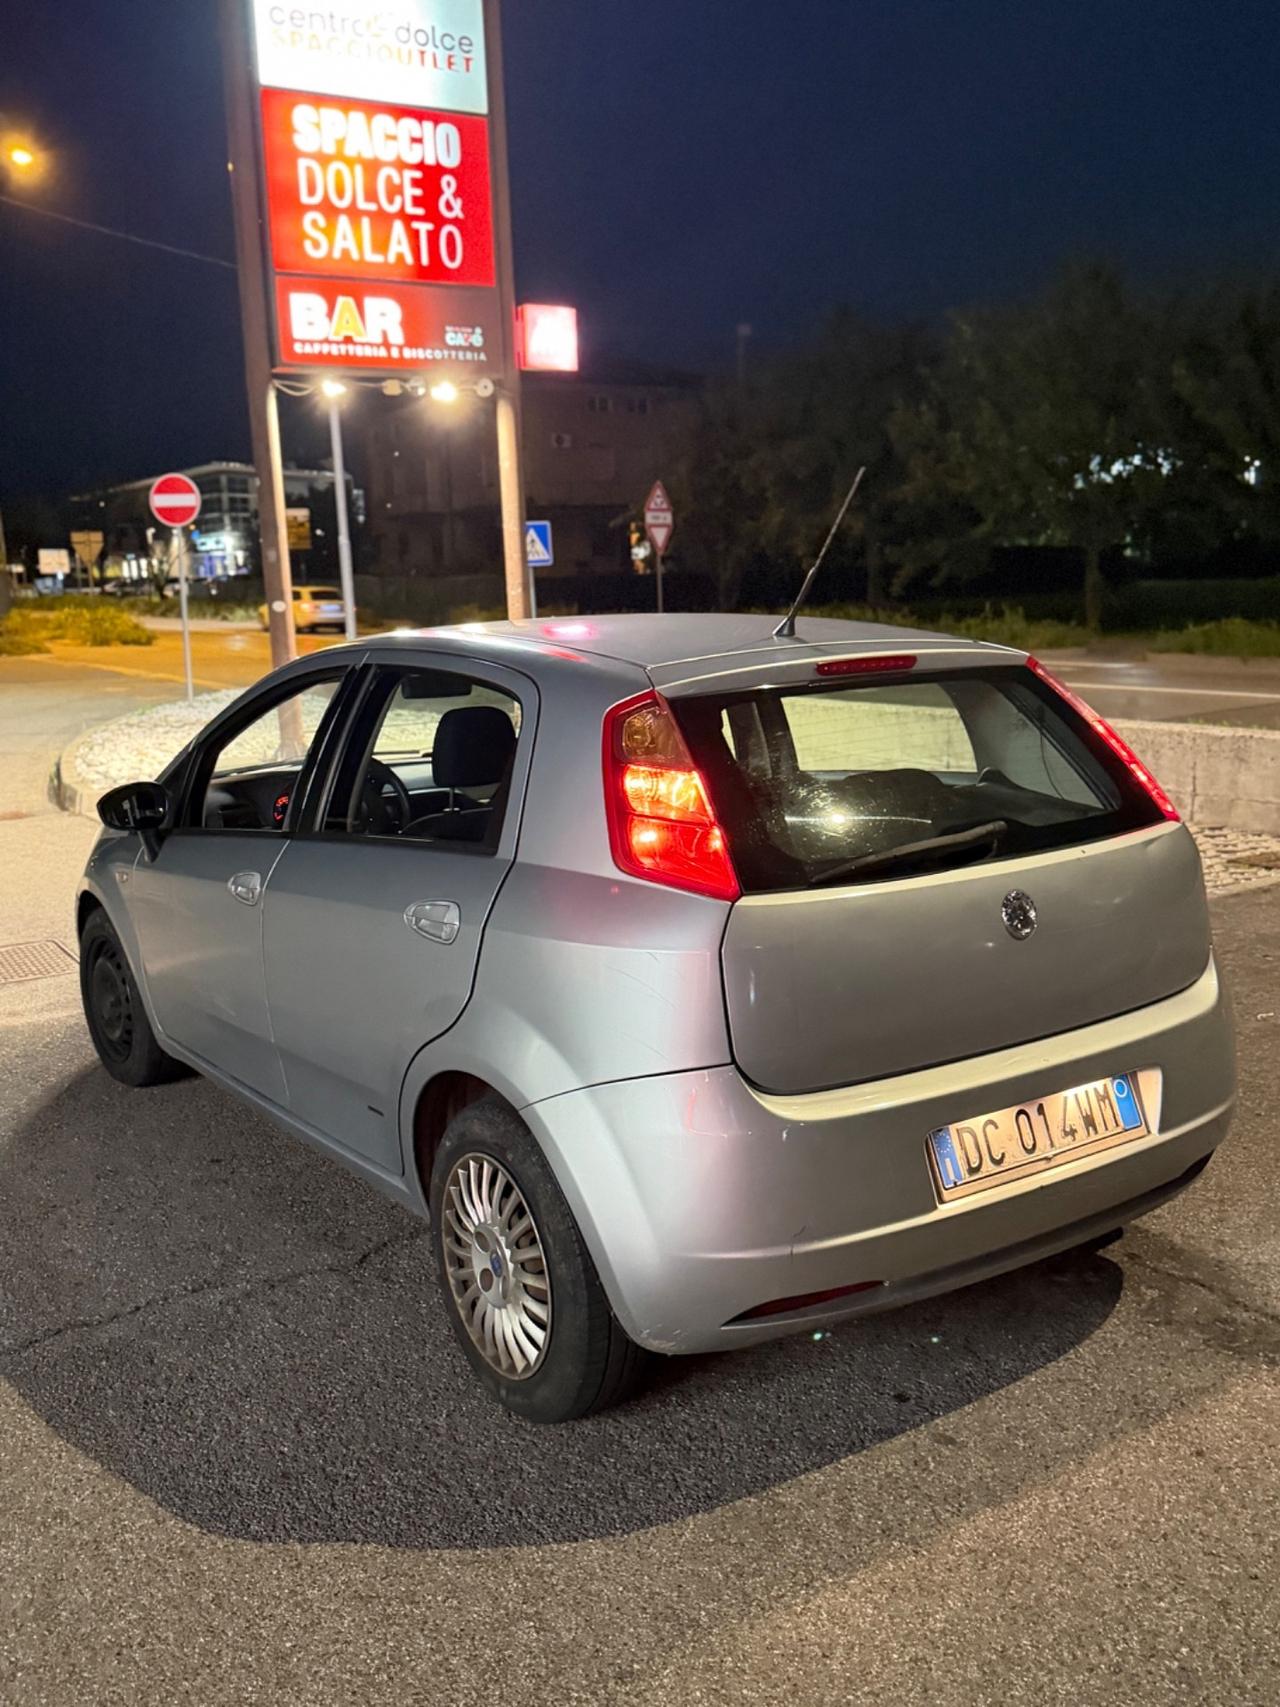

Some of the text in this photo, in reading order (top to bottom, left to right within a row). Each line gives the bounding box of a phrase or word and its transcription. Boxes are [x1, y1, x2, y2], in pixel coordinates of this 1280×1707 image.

[394, 20, 475, 55] dolce
[291, 103, 462, 169] SPACCIO
[297, 157, 465, 220] DOLCE &
[302, 211, 463, 270] SALATO
[288, 292, 405, 345] BAR
[956, 1118, 1006, 1176] DC
